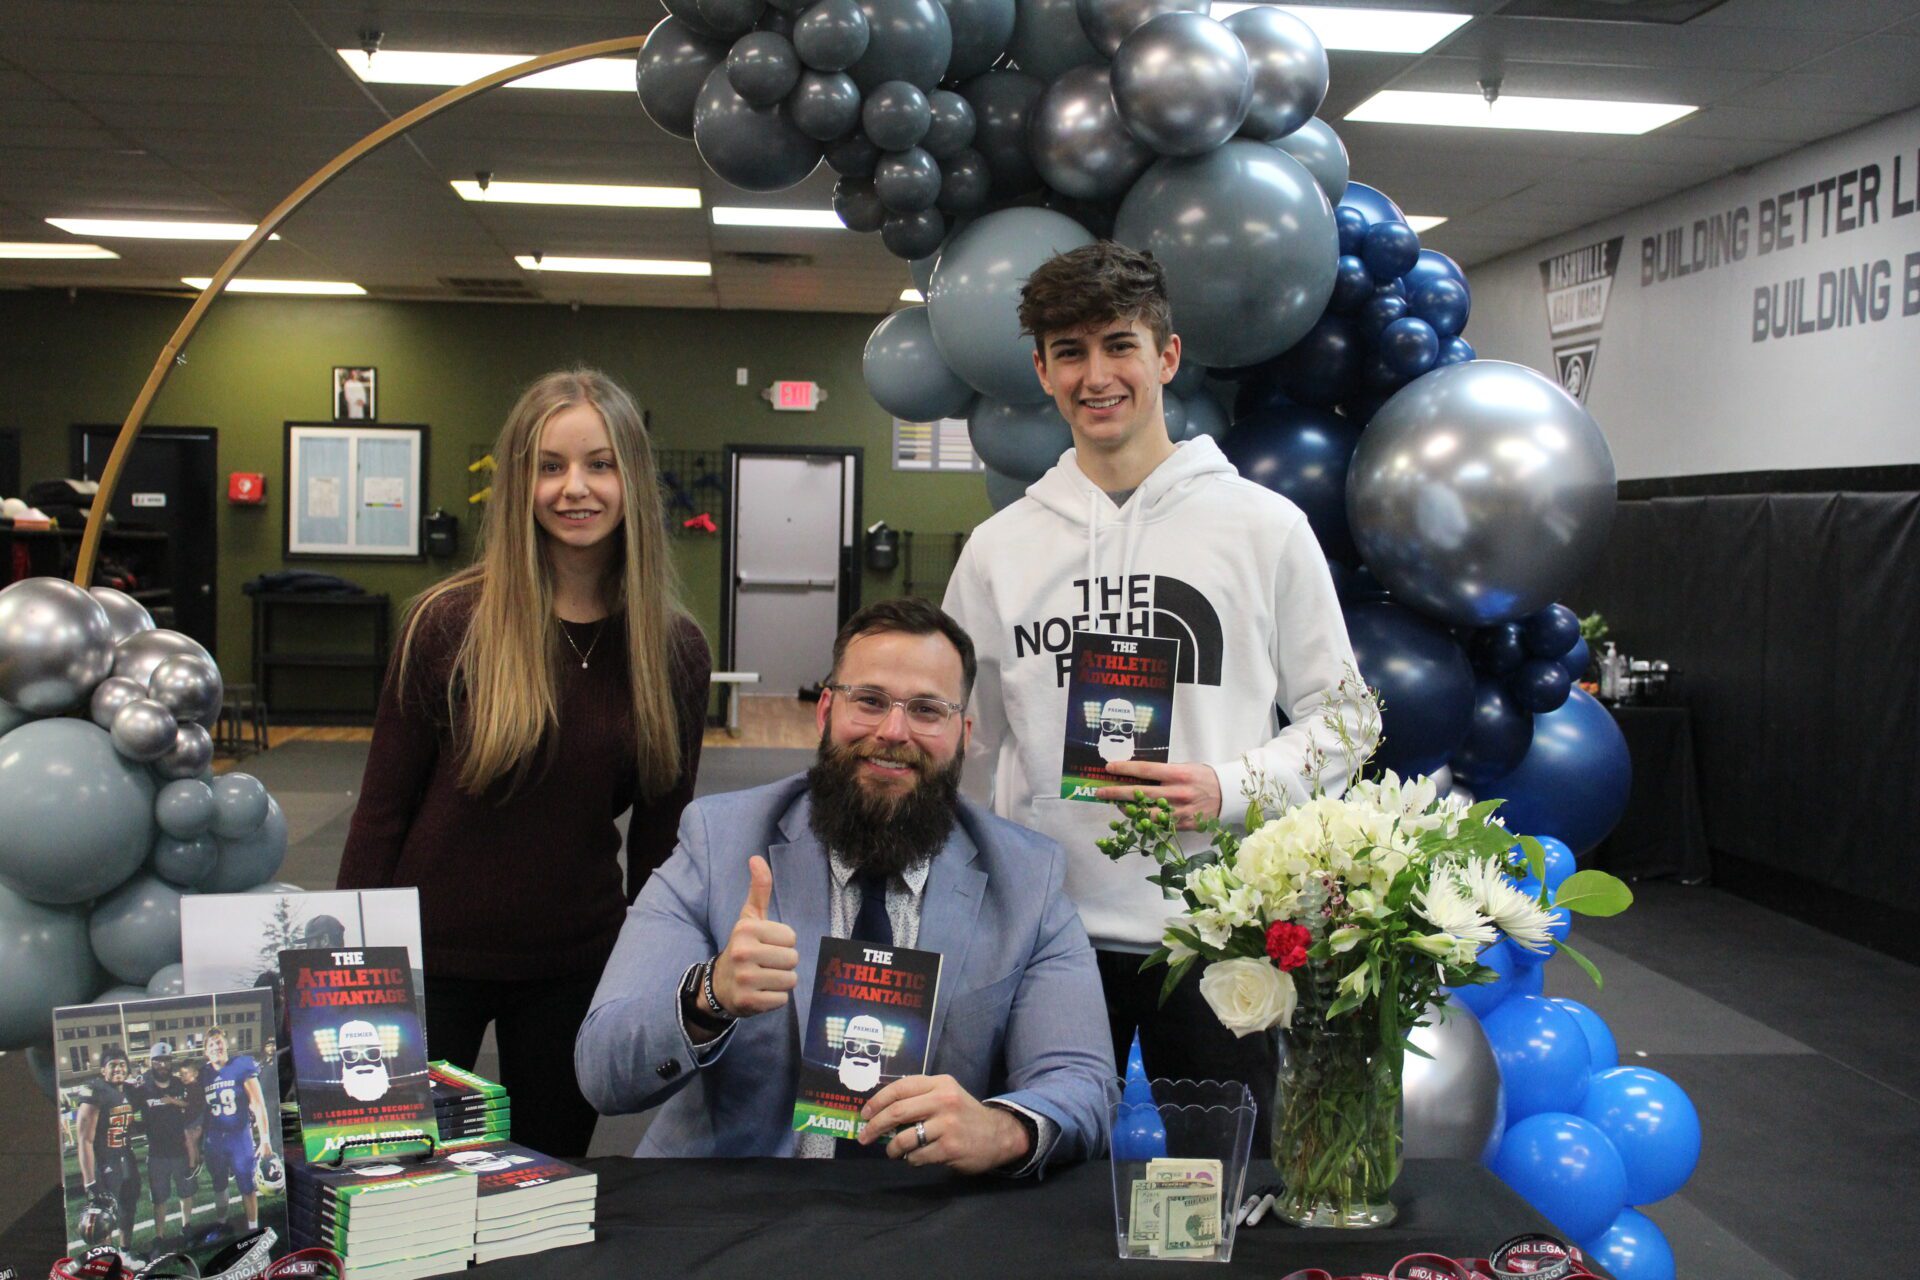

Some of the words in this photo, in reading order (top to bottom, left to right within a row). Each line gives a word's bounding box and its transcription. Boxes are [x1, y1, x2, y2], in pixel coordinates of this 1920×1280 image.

[1641, 205, 1749, 288] BUILDING
[1757, 163, 1881, 257] BETTER
[1752, 258, 1892, 344] BUILDING
[781, 383, 811, 406] EXIT
[1073, 574, 1150, 612] THE
[1111, 640, 1138, 654] THE
[1080, 649, 1168, 674] ATHLETIC
[1078, 670, 1167, 688] ADVANTAGE
[1074, 785, 1098, 797] AAR
[331, 952, 364, 966] THE
[863, 948, 893, 965] THE
[296, 967, 403, 989] ATHLETIC
[824, 956, 926, 989] ATHLETIC
[300, 988, 407, 1009] ADVANTAGE
[822, 977, 924, 1008] ADVANTAGE
[205, 1088, 238, 1116] 59
[807, 1114, 855, 1132] AARON
